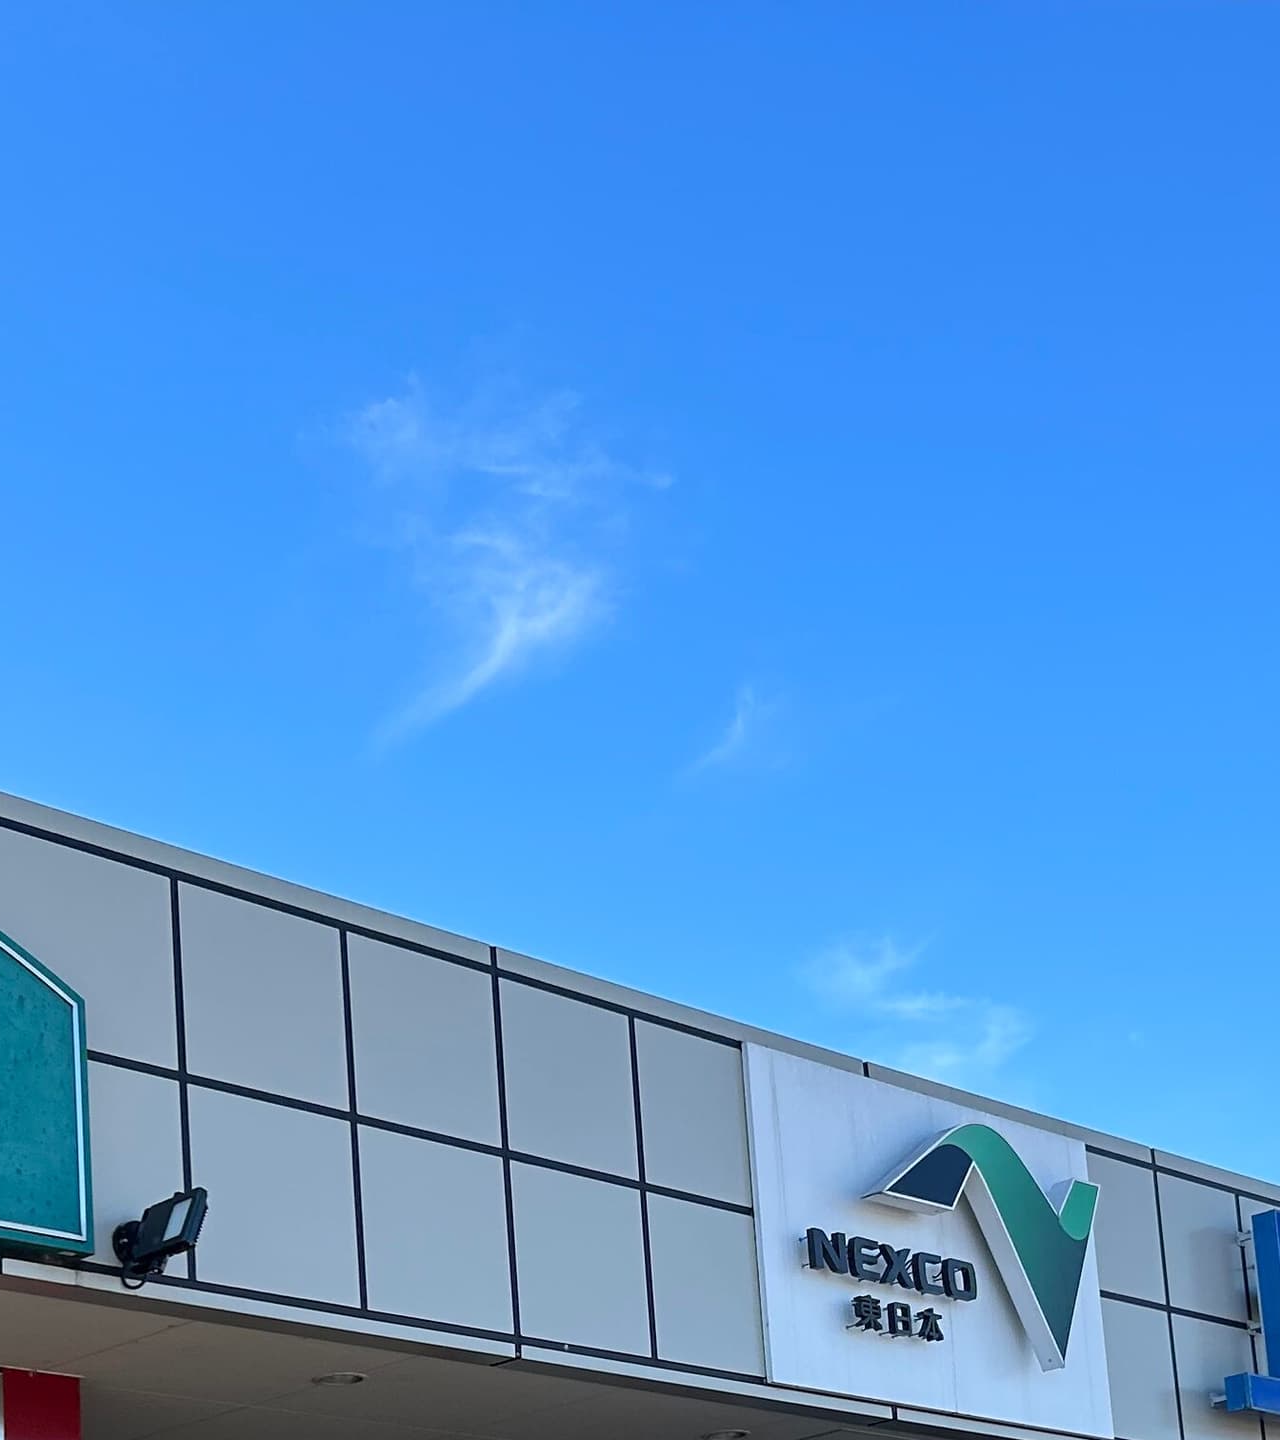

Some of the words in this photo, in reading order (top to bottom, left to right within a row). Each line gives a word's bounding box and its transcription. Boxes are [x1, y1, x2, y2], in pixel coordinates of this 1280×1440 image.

[805, 1227, 978, 1302] NEXCO
[850, 1294, 945, 1343] 東日本
